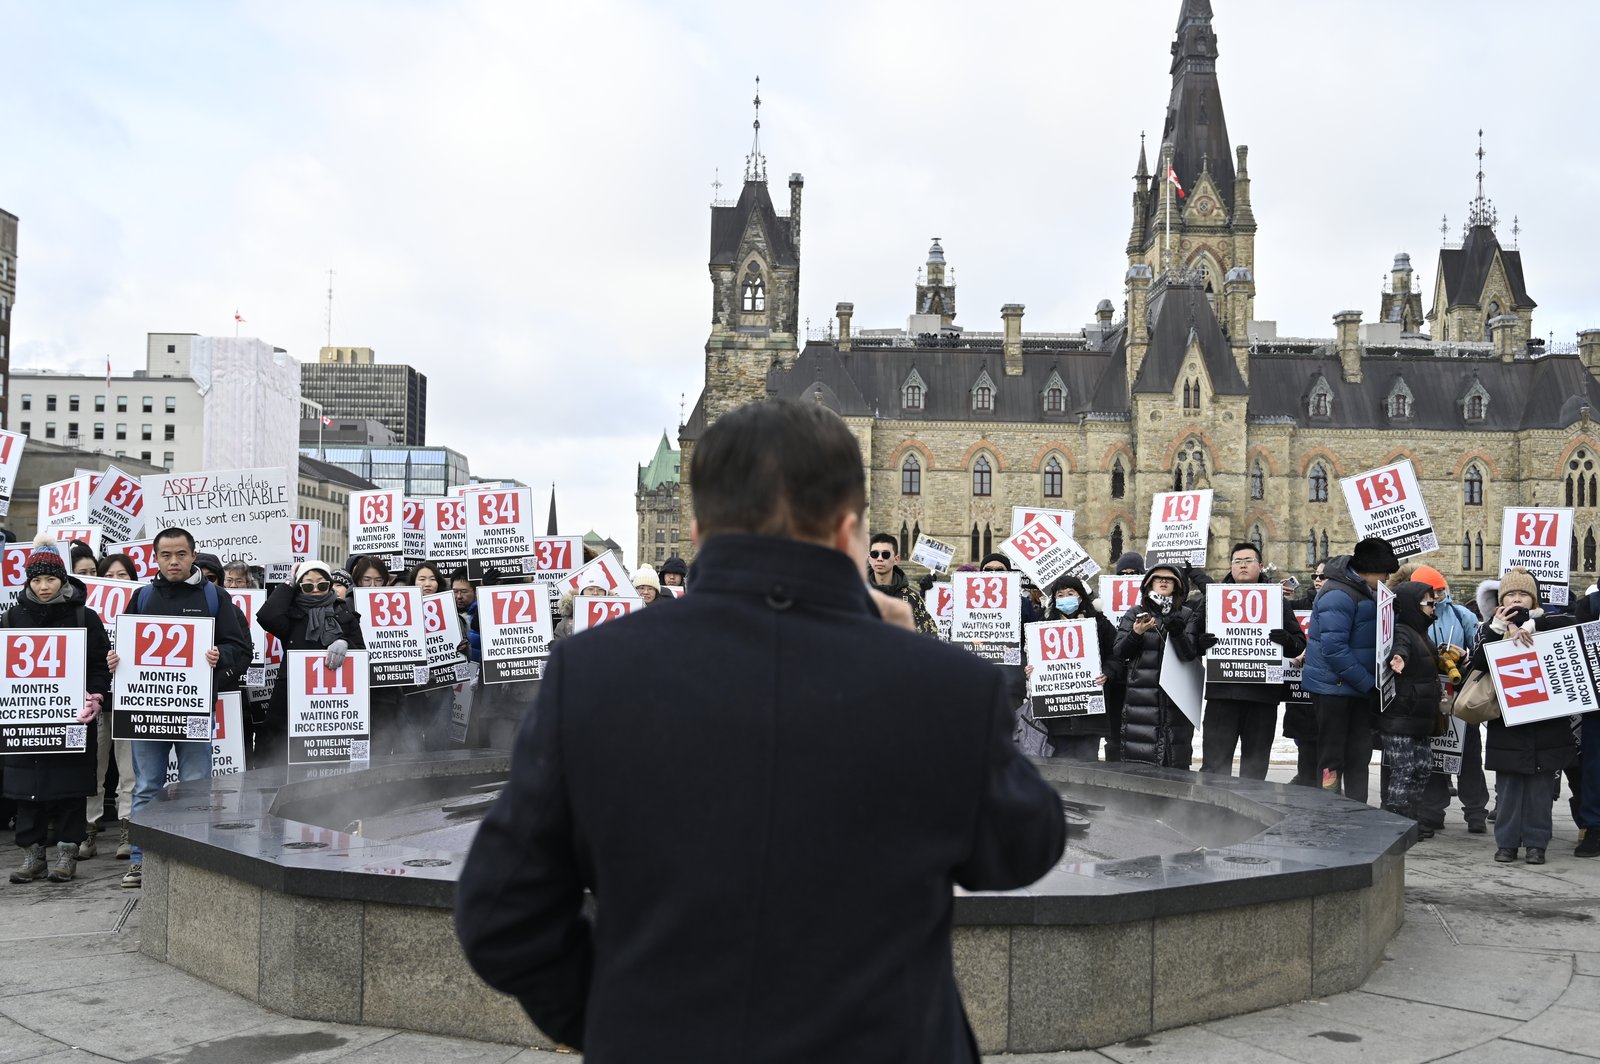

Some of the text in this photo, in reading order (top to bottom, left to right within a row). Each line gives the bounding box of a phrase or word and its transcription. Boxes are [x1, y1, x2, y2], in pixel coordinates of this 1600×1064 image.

[162, 474, 270, 496] ASSEZ des délais
[1362, 472, 1399, 509] 13
[51, 482, 76, 515] 34
[111, 480, 142, 515] 31
[163, 486, 288, 512] INTERMINABLE
[363, 495, 388, 524] 63
[482, 493, 516, 524] 34
[1166, 495, 1195, 521] 19
[1370, 504, 1406, 521] MONTHS
[102, 505, 130, 524] MONTHS
[155, 508, 289, 530] Nos vies sont en suspens.
[440, 502, 466, 530] 38
[51, 515, 76, 526] MONTHS
[91, 508, 132, 535] WAITING FOR
[1364, 510, 1418, 532] WAITING FOR
[363, 526, 389, 534] MONTHS
[483, 527, 516, 536] MONTHS
[1164, 523, 1193, 531] MONTHS
[1382, 518, 1425, 538] RESPONSE
[1519, 513, 1555, 546] 37
[356, 533, 396, 542] WAITING FOR
[476, 536, 525, 546] WAITING FOR
[1016, 524, 1052, 557] 35
[1157, 532, 1185, 540] WAITING
[195, 534, 262, 550] ransparence.
[352, 541, 400, 551] IRCC RESPONSE
[433, 540, 463, 549] WAITING
[1166, 539, 1203, 547] RESPONSE
[429, 549, 444, 558] IRCC
[472, 544, 530, 556] IRCC RESPONSE
[538, 541, 568, 570] 37
[1518, 549, 1552, 559] MONTHS
[1036, 546, 1062, 566] MONTHS
[480, 560, 490, 568] NO
[1036, 557, 1062, 576] WAITING
[1509, 558, 1560, 569] WAITING FOR
[970, 577, 1003, 608] 33
[86, 584, 126, 624] 40
[374, 592, 408, 626] 33
[497, 591, 532, 624] 72
[1225, 590, 1263, 623] 30
[969, 611, 1003, 620] MONTHS
[500, 626, 534, 636] MONTHS
[961, 621, 1011, 630] WAITING FOR
[376, 630, 409, 639] MONTHS
[956, 630, 1015, 640] IRCC RESPONSE
[1226, 628, 1263, 636] MONTHS
[140, 623, 188, 666] 22
[368, 639, 418, 649] WAITING FOR
[491, 635, 544, 646] WAITING FOR
[1043, 626, 1080, 660] 90
[1216, 638, 1272, 646] WAITING FOR
[440, 643, 454, 652] FOR
[487, 645, 549, 657] IRCC RESPONSE
[1211, 647, 1277, 656] IRCC RESPONSE
[1552, 641, 1566, 661] FOR
[11, 635, 60, 678] 34
[383, 649, 423, 658] RESPONSE
[373, 665, 383, 673] NO
[496, 662, 506, 670] NO
[1047, 662, 1082, 672] MONTHS
[1563, 633, 1592, 706] IRCC RESPONSE
[139, 671, 187, 683] MONTHS
[312, 657, 348, 694] 11
[387, 672, 414, 680] RESULTS
[500, 667, 540, 677] NO RESULTS
[1039, 671, 1092, 682] WAITING FOR
[1234, 670, 1266, 678] RESULTS
[1283, 670, 1301, 678] IRCC
[1543, 654, 1563, 695] MONTHS
[1497, 659, 1546, 699] 14
[1558, 663, 1578, 703] WAITING
[11, 684, 59, 694] MONTHS
[127, 683, 198, 696] WAITING FOR
[1035, 680, 1097, 693] IRCC RESPONSE
[0, 696, 71, 707] WAITING FOR
[120, 695, 204, 708] IRCC RESPONSE
[310, 699, 349, 709] MONTHS
[1044, 694, 1090, 705] NO TIMELINES
[18, 708, 78, 720] RESPONSE
[1048, 704, 1088, 713] NO RESULTS
[130, 714, 144, 724] NO
[300, 710, 359, 721] WAITING FOR
[3, 727, 66, 737] NO TIMELINES
[134, 724, 188, 735] NO RESULTS
[294, 721, 364, 733] IRCC RESPONSE
[6, 737, 62, 748] NO RESULTS
[304, 740, 314, 748] NO
[307, 747, 352, 757] NO RESULTS
